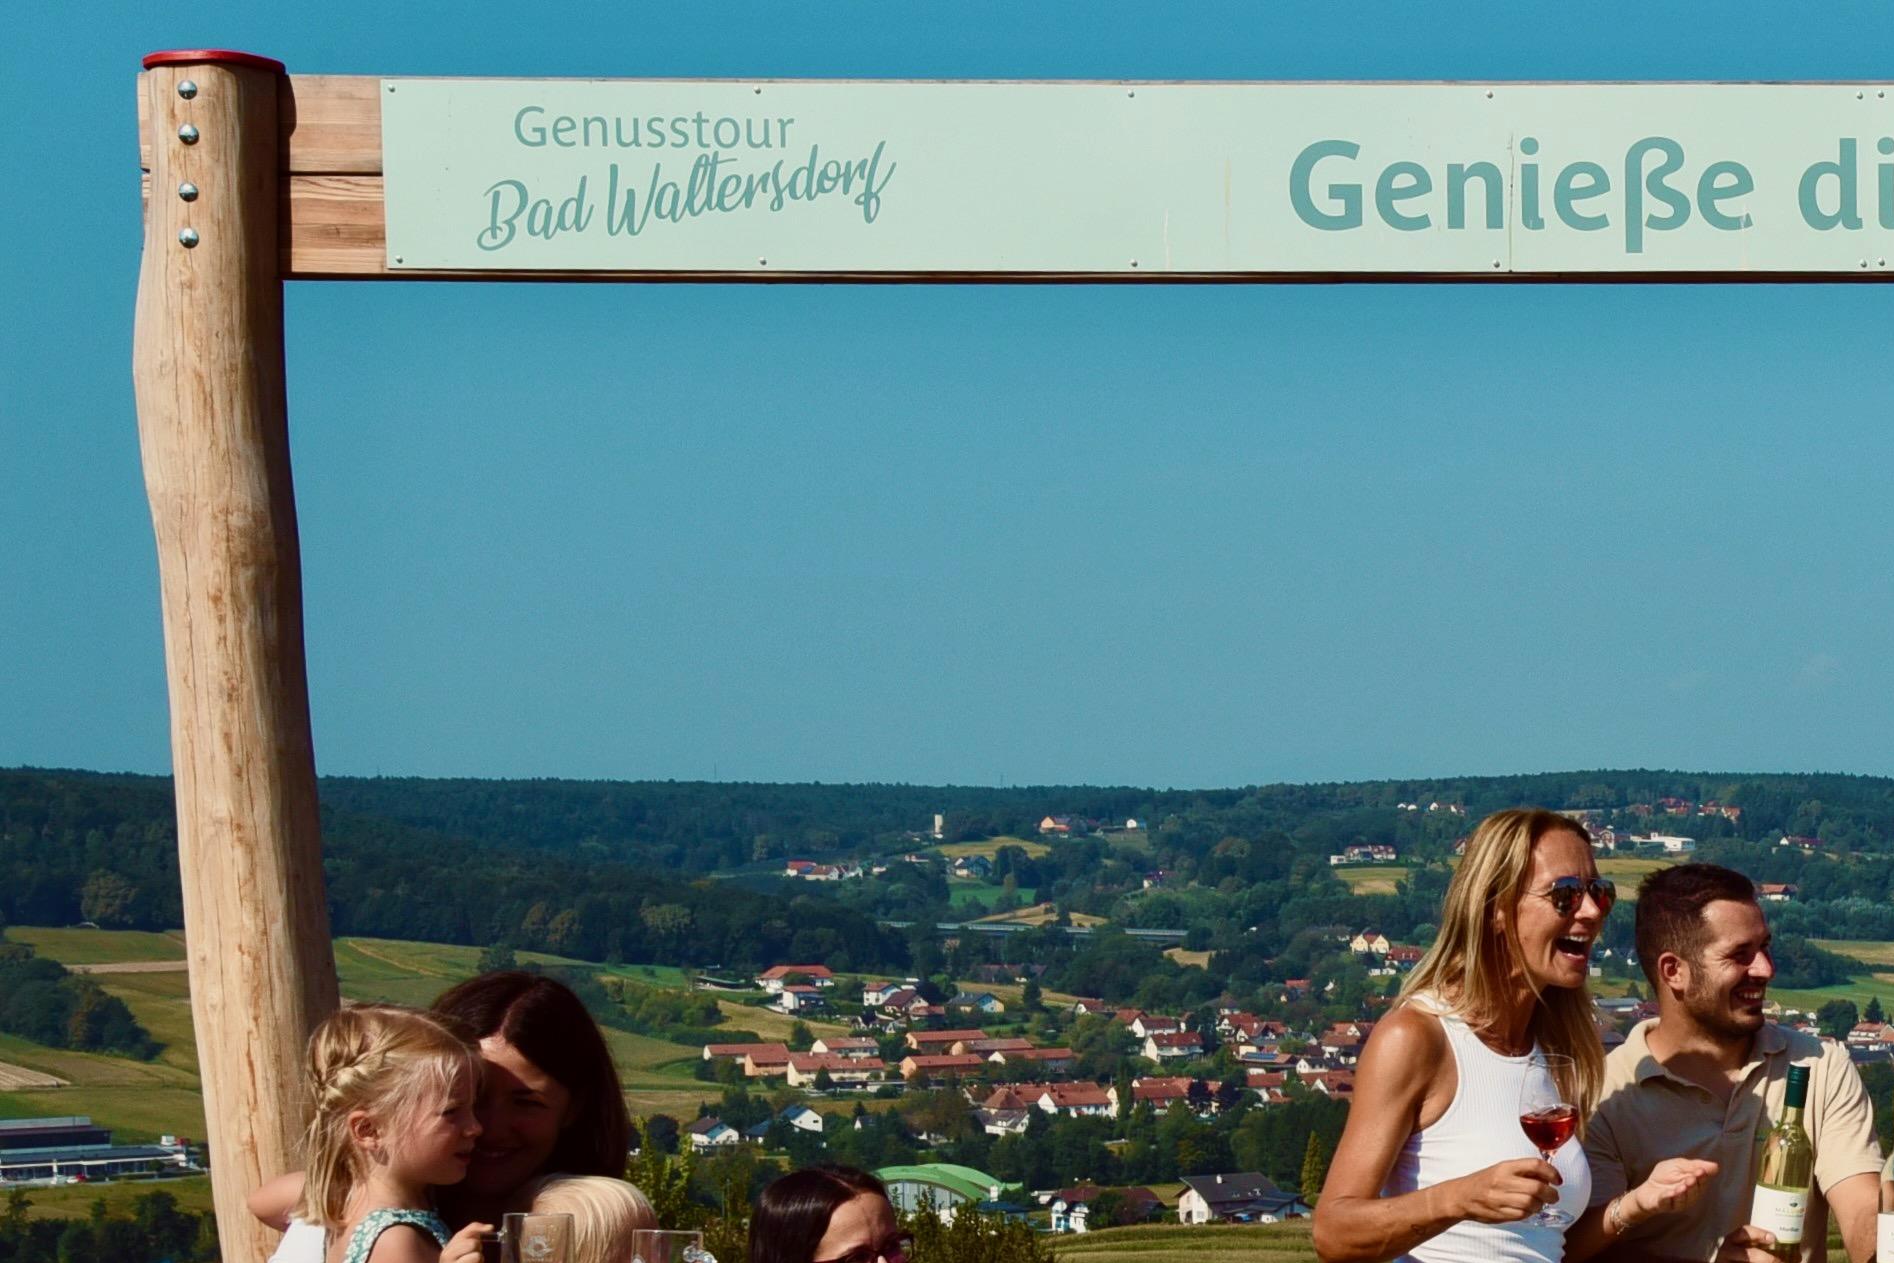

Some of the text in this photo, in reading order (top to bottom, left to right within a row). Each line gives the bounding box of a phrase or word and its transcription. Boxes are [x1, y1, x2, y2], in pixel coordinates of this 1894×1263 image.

[514, 105, 795, 149] Genusstour
[477, 140, 898, 252] Bad Waltersdorf
[1289, 137, 1755, 253] Genieße
